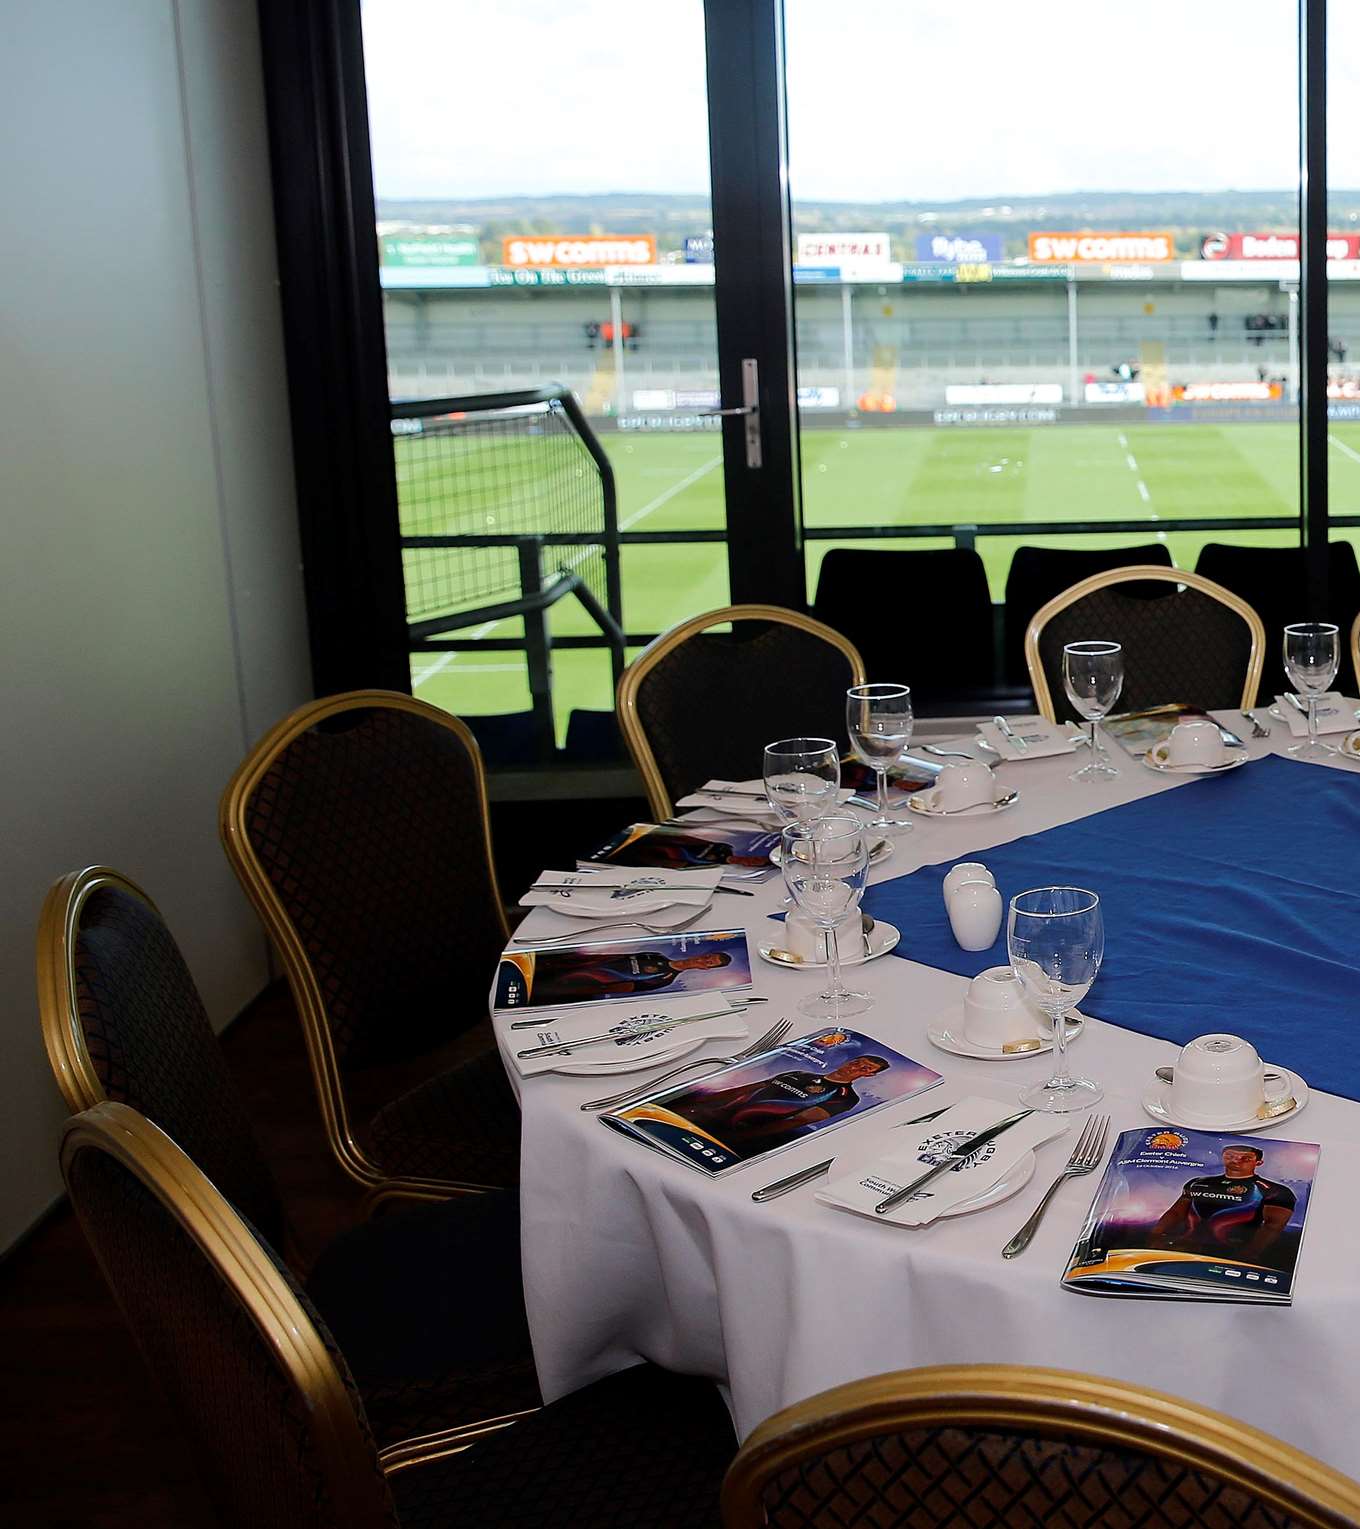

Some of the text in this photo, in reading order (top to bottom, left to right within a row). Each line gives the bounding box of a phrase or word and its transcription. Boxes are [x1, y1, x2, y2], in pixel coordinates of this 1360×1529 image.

[917, 1131, 977, 1151] EXETER
[1169, 1159, 1205, 1168] Auvergne
[1202, 1192, 1243, 1202] comms
